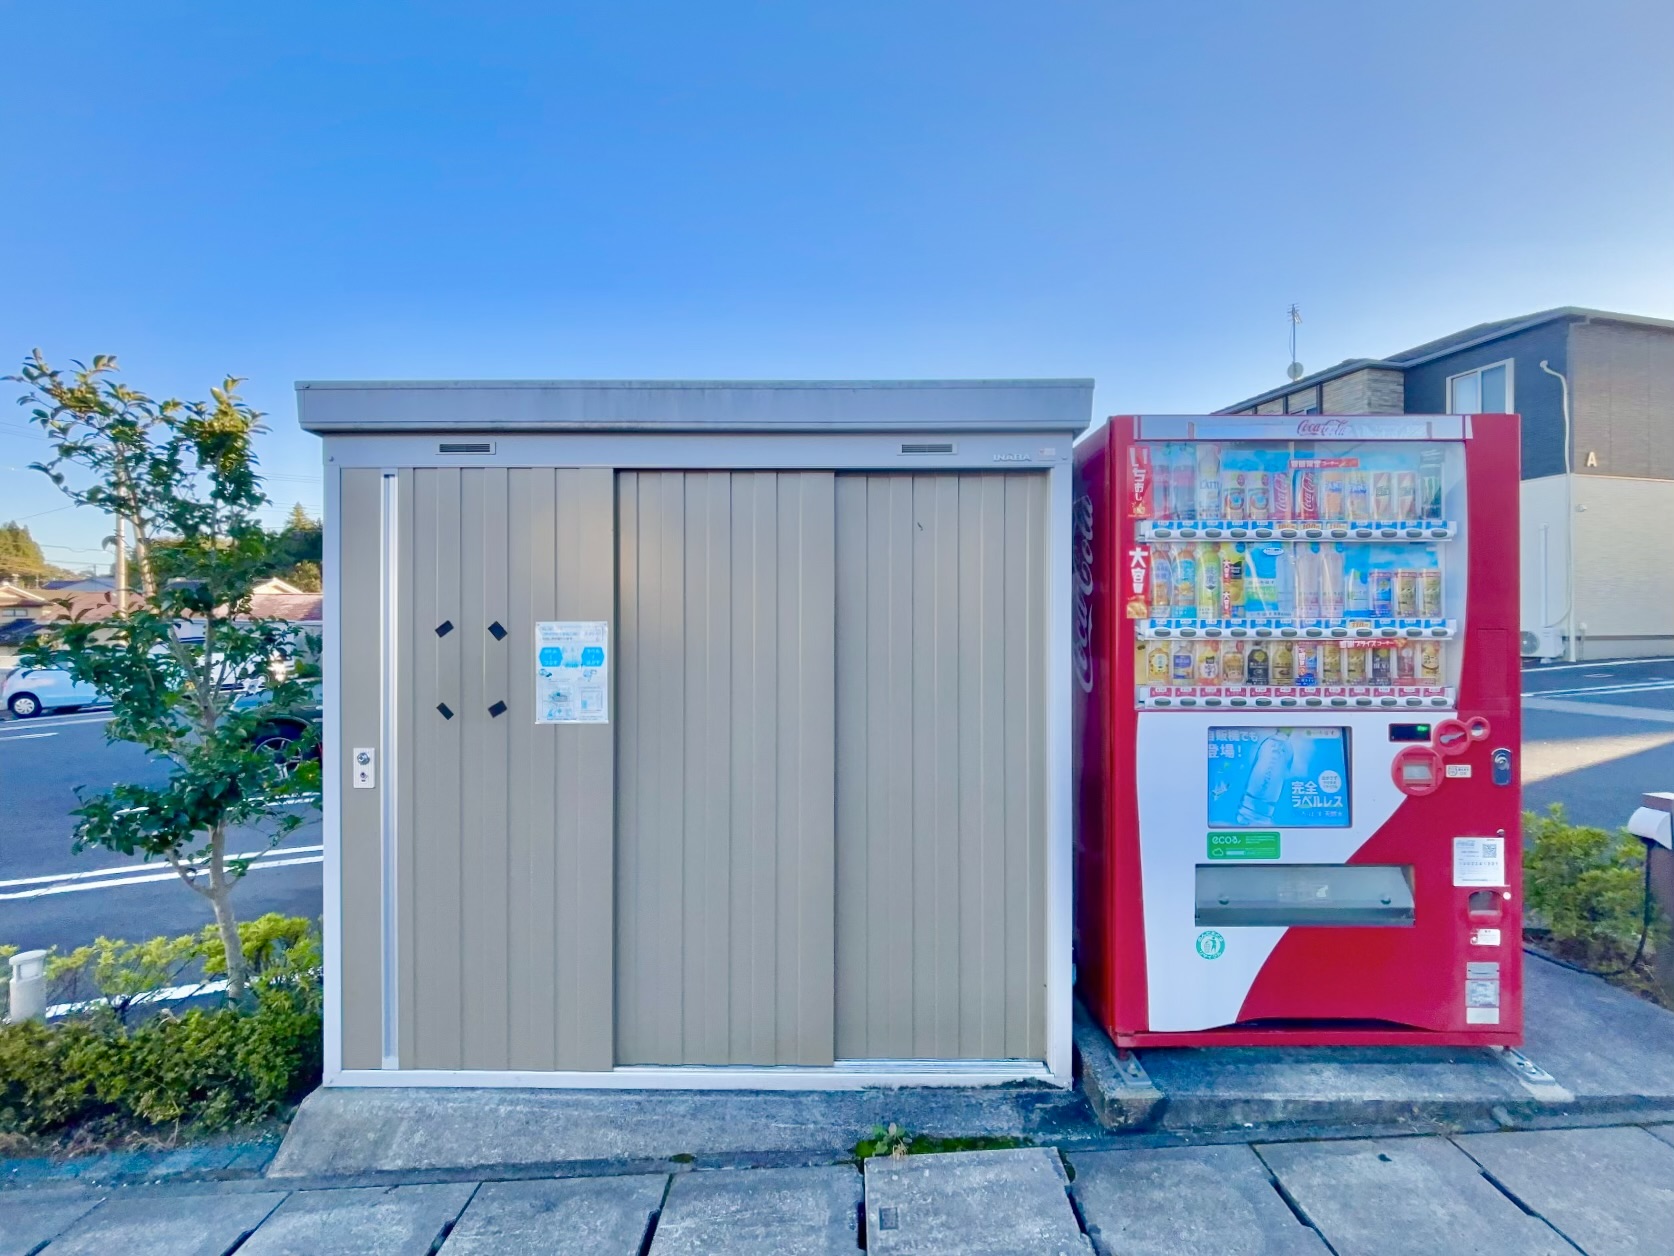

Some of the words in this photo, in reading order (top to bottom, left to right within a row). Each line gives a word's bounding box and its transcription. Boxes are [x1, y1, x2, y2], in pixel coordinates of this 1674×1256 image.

[1587, 451, 1597, 467] A
[1129, 447, 1148, 501] いちおし
[1291, 780, 1319, 795] 完全
[1291, 795, 1344, 808] ラベルレス
